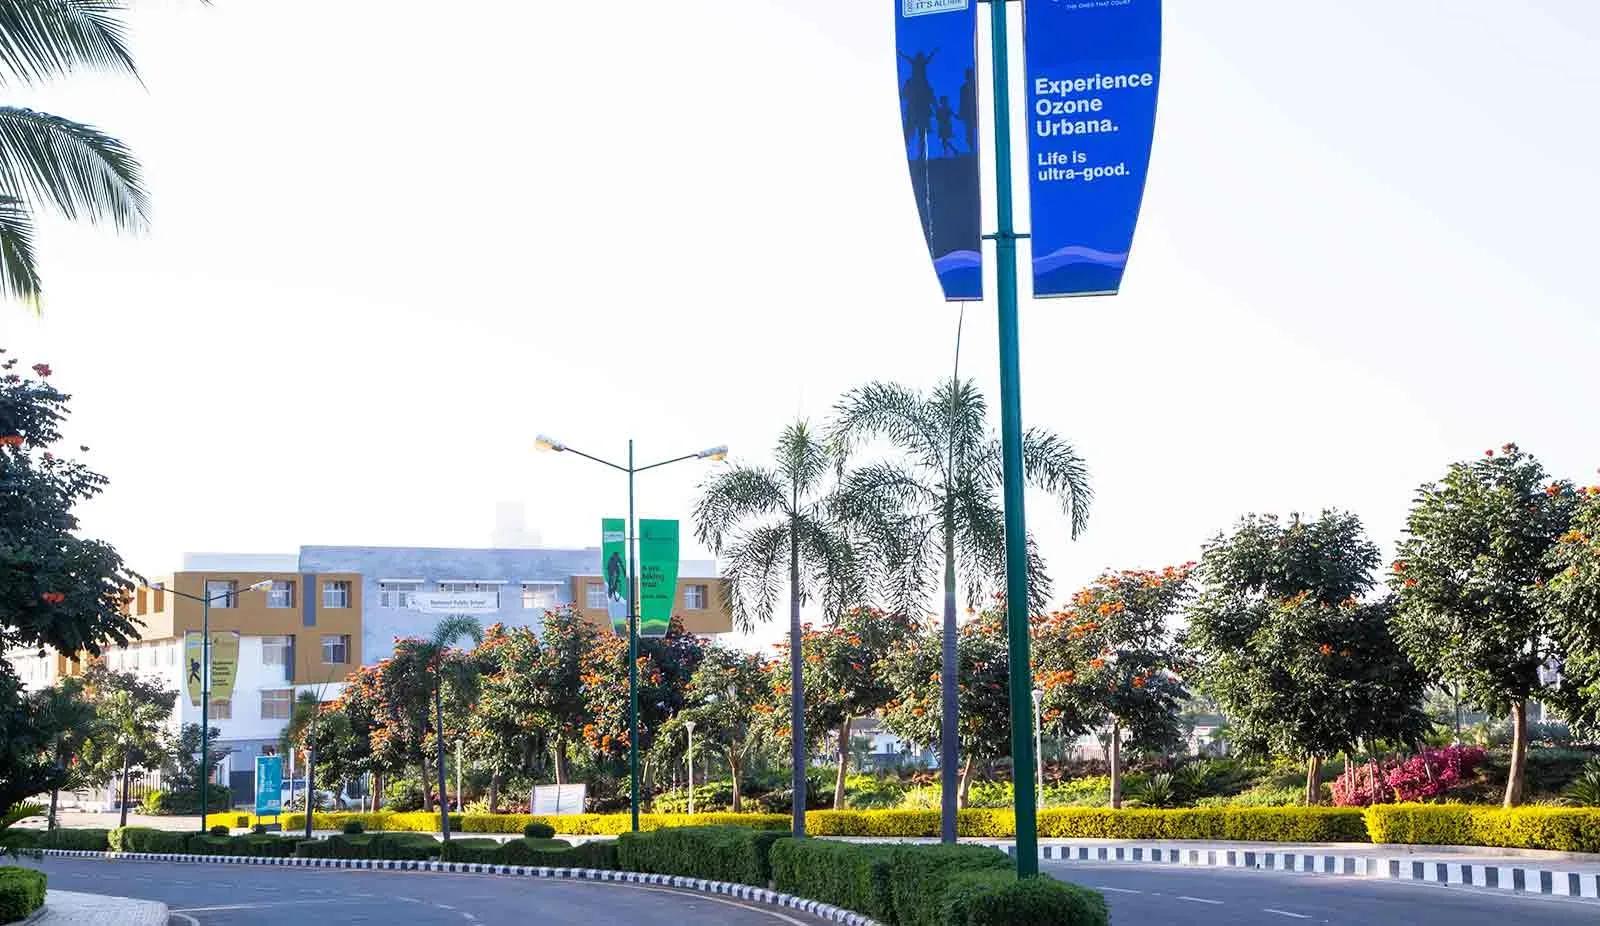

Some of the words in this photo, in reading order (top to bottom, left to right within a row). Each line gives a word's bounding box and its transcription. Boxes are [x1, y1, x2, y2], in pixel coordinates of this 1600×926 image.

[1035, 73, 1153, 97] Experience
[1036, 98, 1103, 116] Ozone
[1037, 119, 1119, 137] Urbana.
[1038, 152, 1068, 166] Life
[1072, 150, 1087, 163] is
